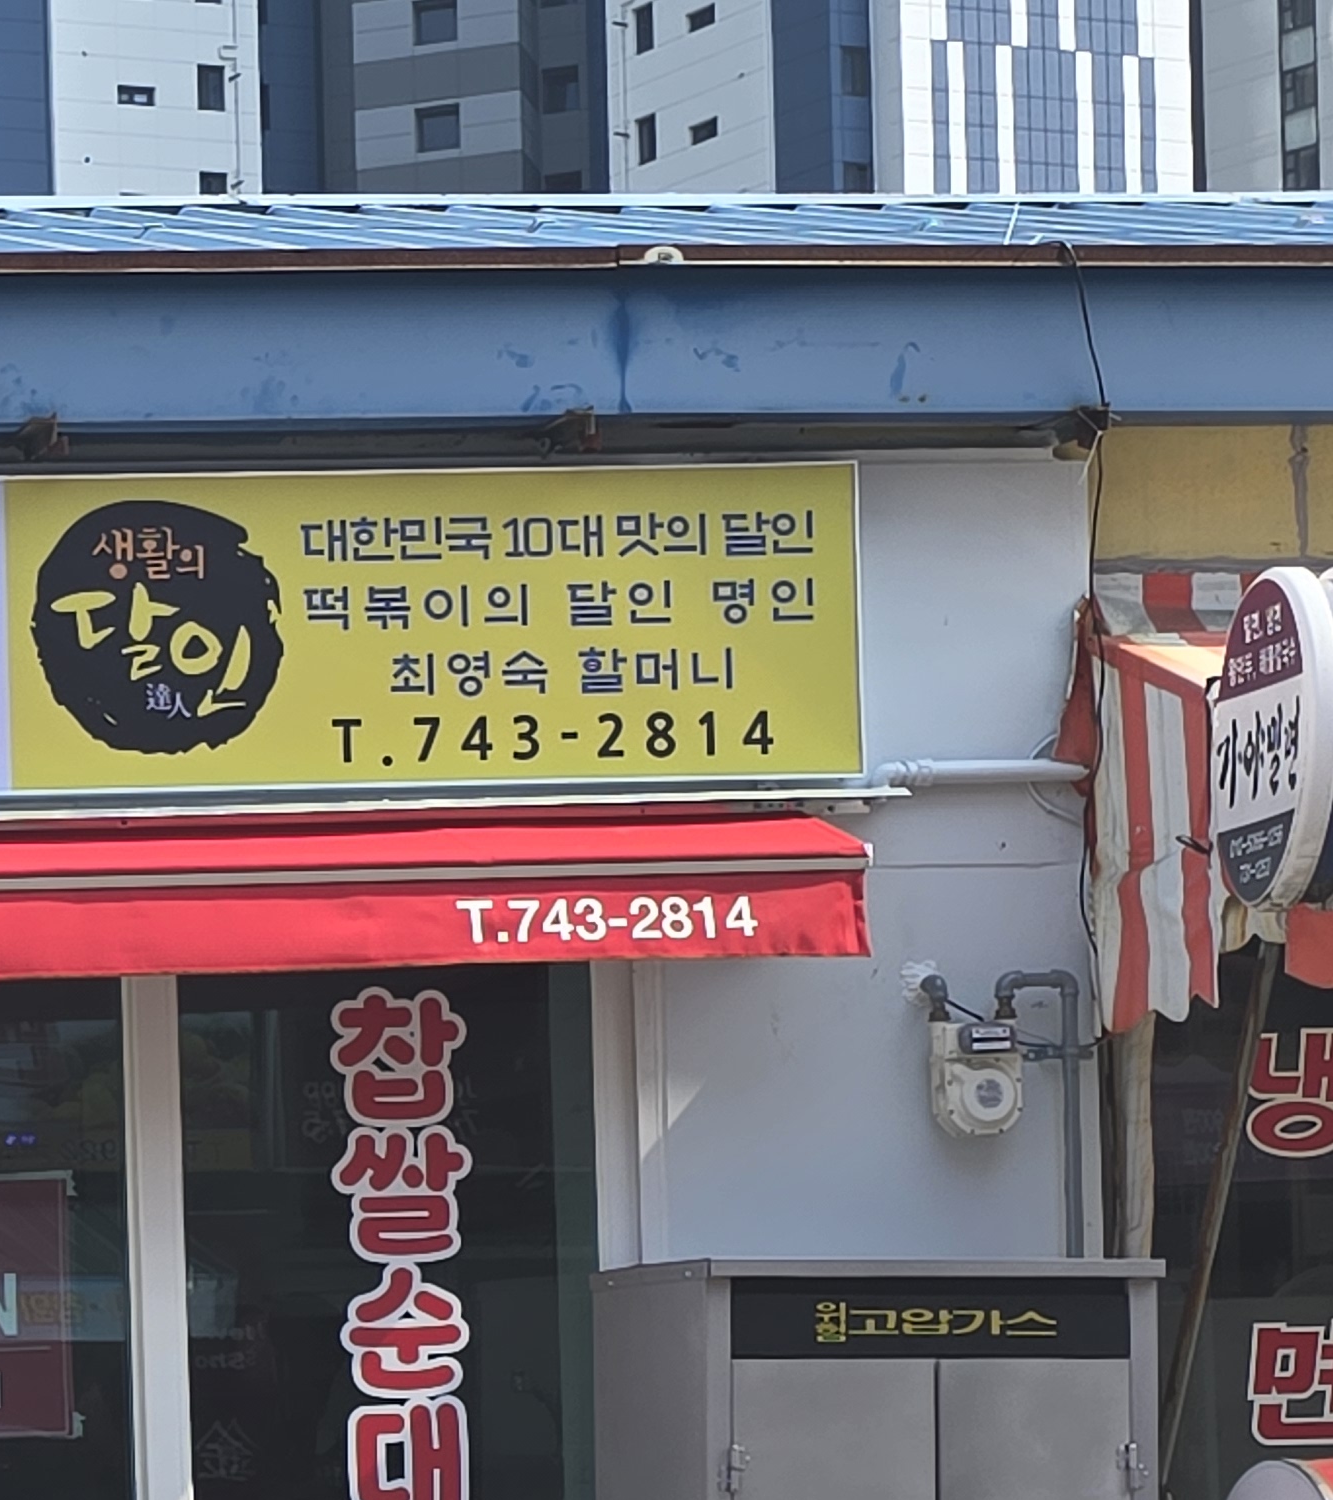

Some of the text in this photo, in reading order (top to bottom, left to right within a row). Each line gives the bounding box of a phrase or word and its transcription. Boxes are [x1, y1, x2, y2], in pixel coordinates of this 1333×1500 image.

[92, 526, 204, 580] 생활의
[300, 515, 493, 562] 대한민국
[616, 511, 707, 558] 맛의
[721, 509, 814, 557] 달인
[303, 577, 814, 631] 떡볶이의 달인 명인
[50, 582, 251, 711] 달인
[390, 646, 733, 697] 최영숙 할머니
[331, 710, 774, 767] T.743-2814
[455, 895, 759, 944] T.743-2814
